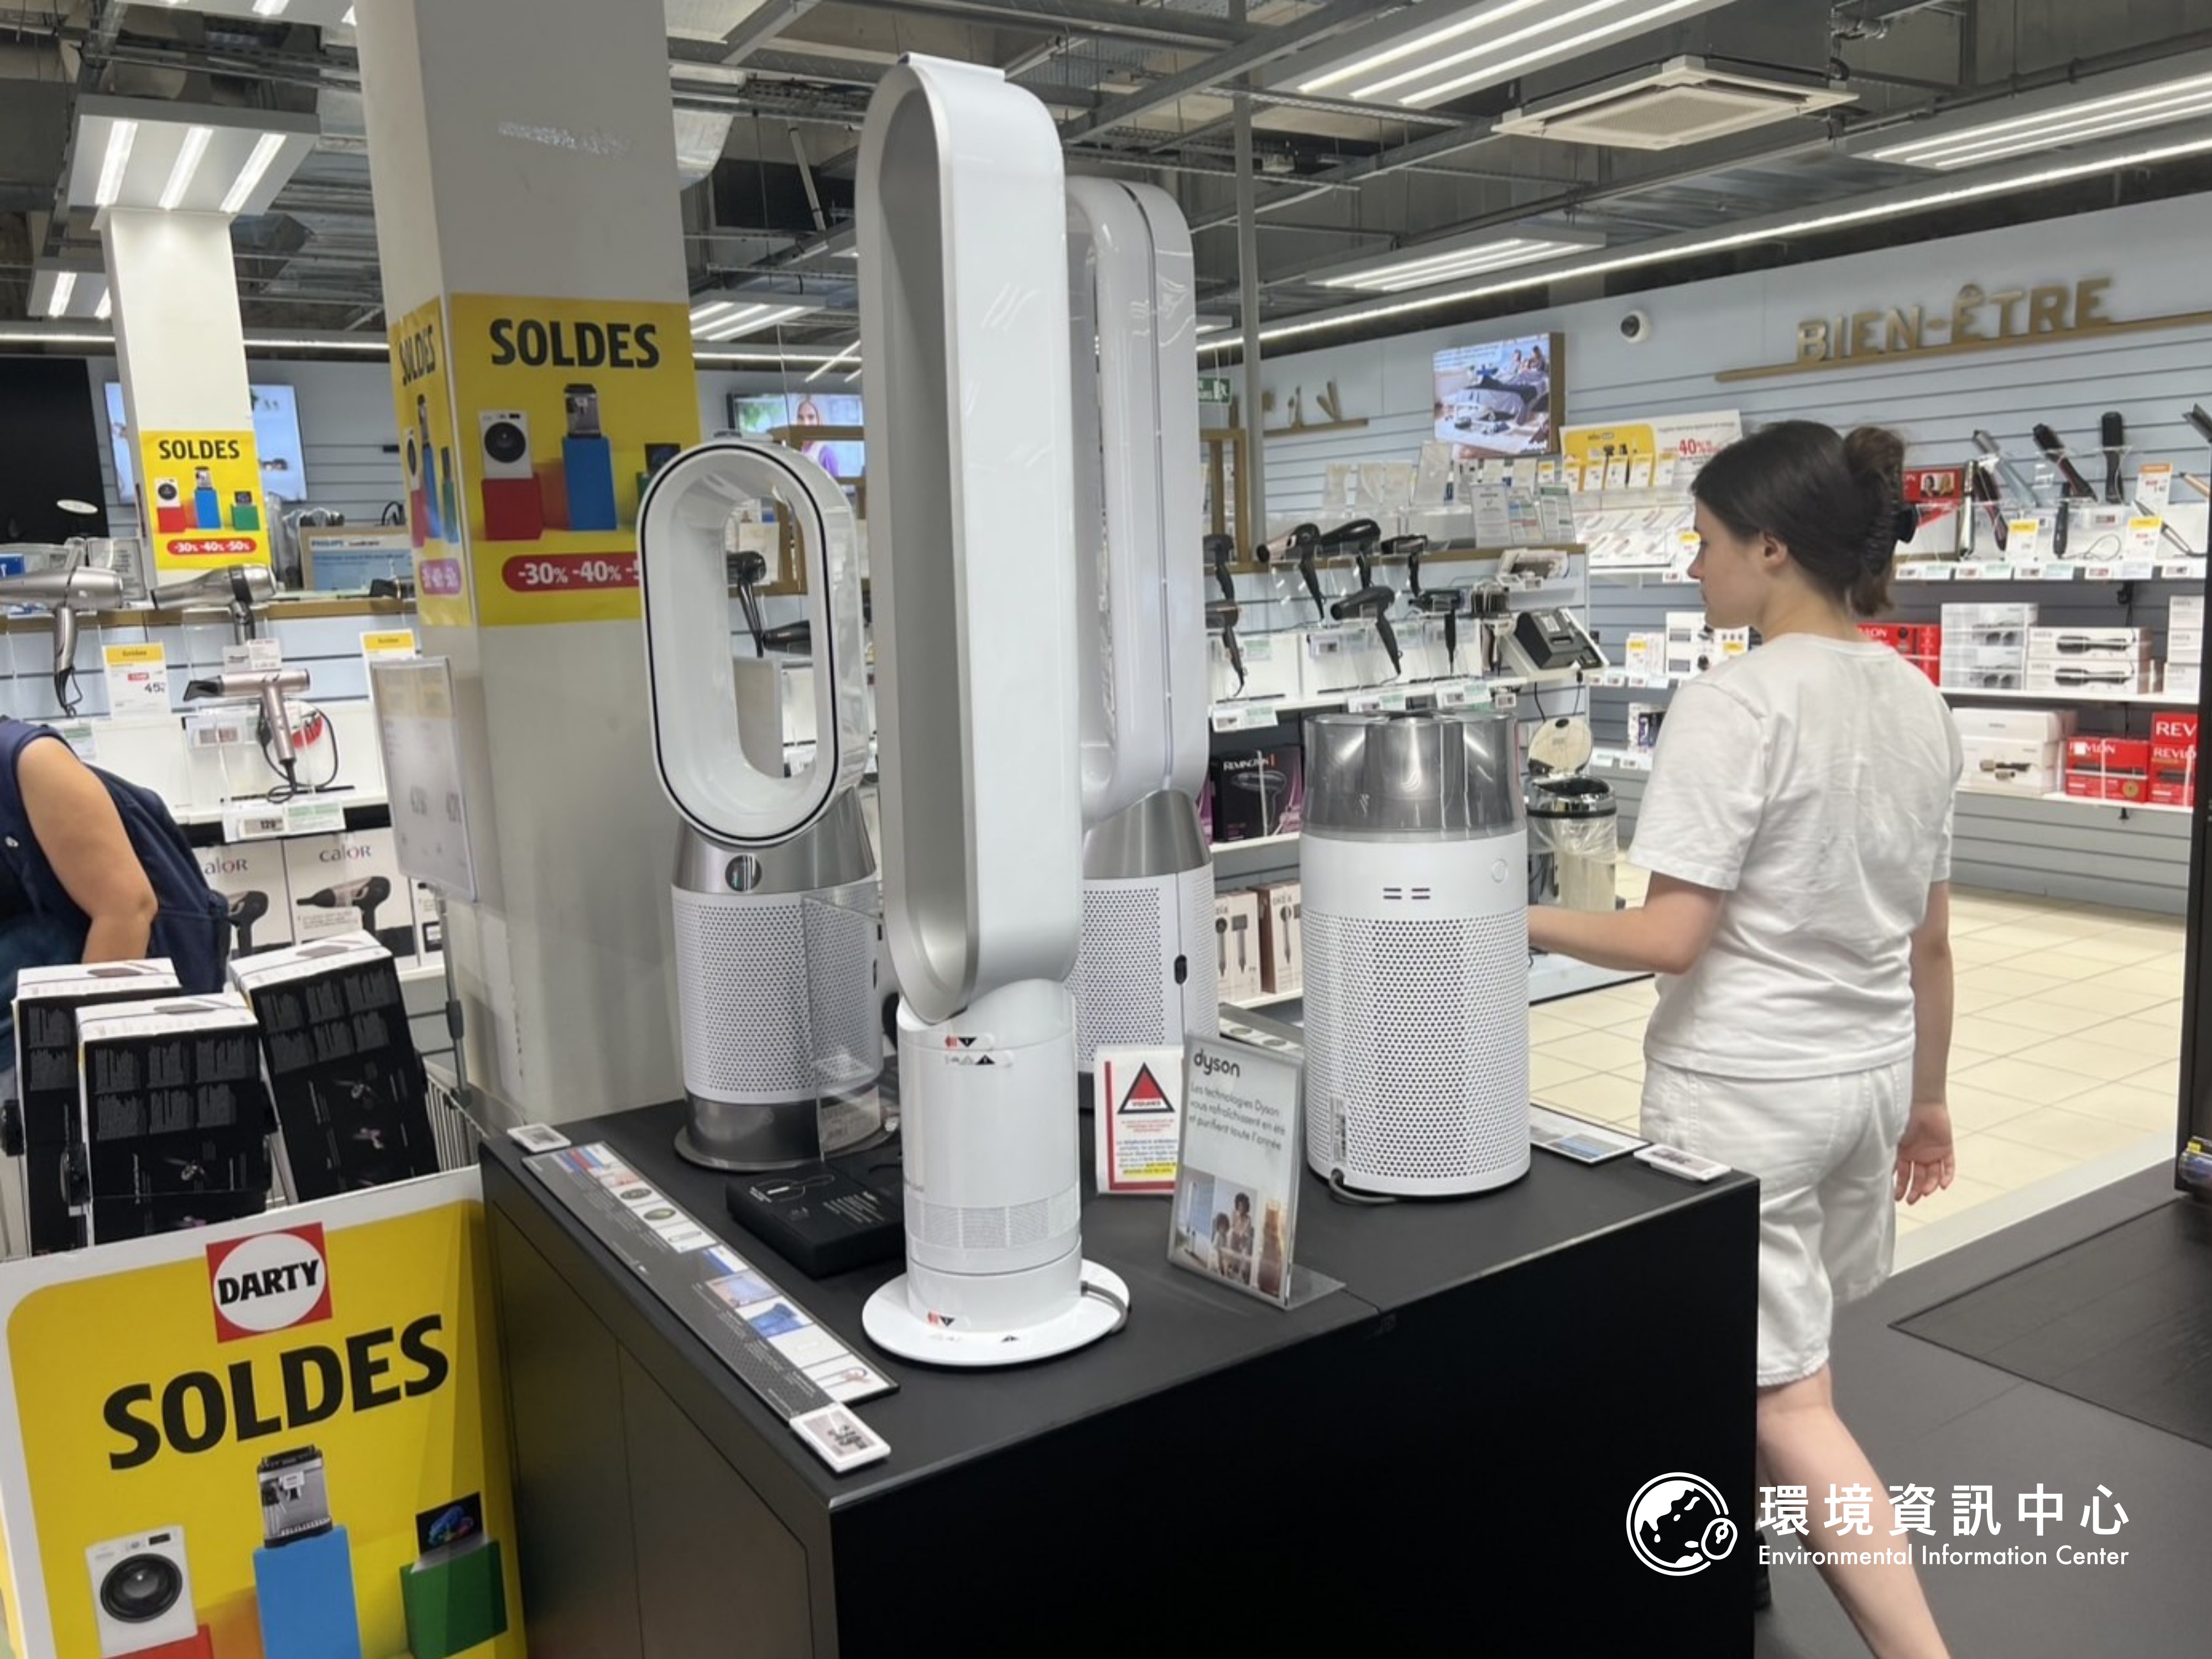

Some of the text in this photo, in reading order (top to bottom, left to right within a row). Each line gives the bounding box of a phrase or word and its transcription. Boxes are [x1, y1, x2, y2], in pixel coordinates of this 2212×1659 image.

[1796, 276, 2112, 362] BIEN-ÊTRE
[399, 325, 436, 386] SOLDES
[490, 318, 659, 368] SOLDES
[159, 440, 240, 460] SOLDES
[174, 540, 251, 552] -30% -40% -50%
[518, 559, 641, 586] -30% -40% -5
[2156, 721, 2198, 737] REV
[2153, 747, 2197, 759] REVLO
[1194, 1047, 1240, 1078] dyson
[1204, 1086, 1253, 1109] technologies
[1255, 1098, 1280, 1117] Dyson
[217, 1259, 320, 1306] DARTY
[103, 1313, 450, 1471] SOLDES
